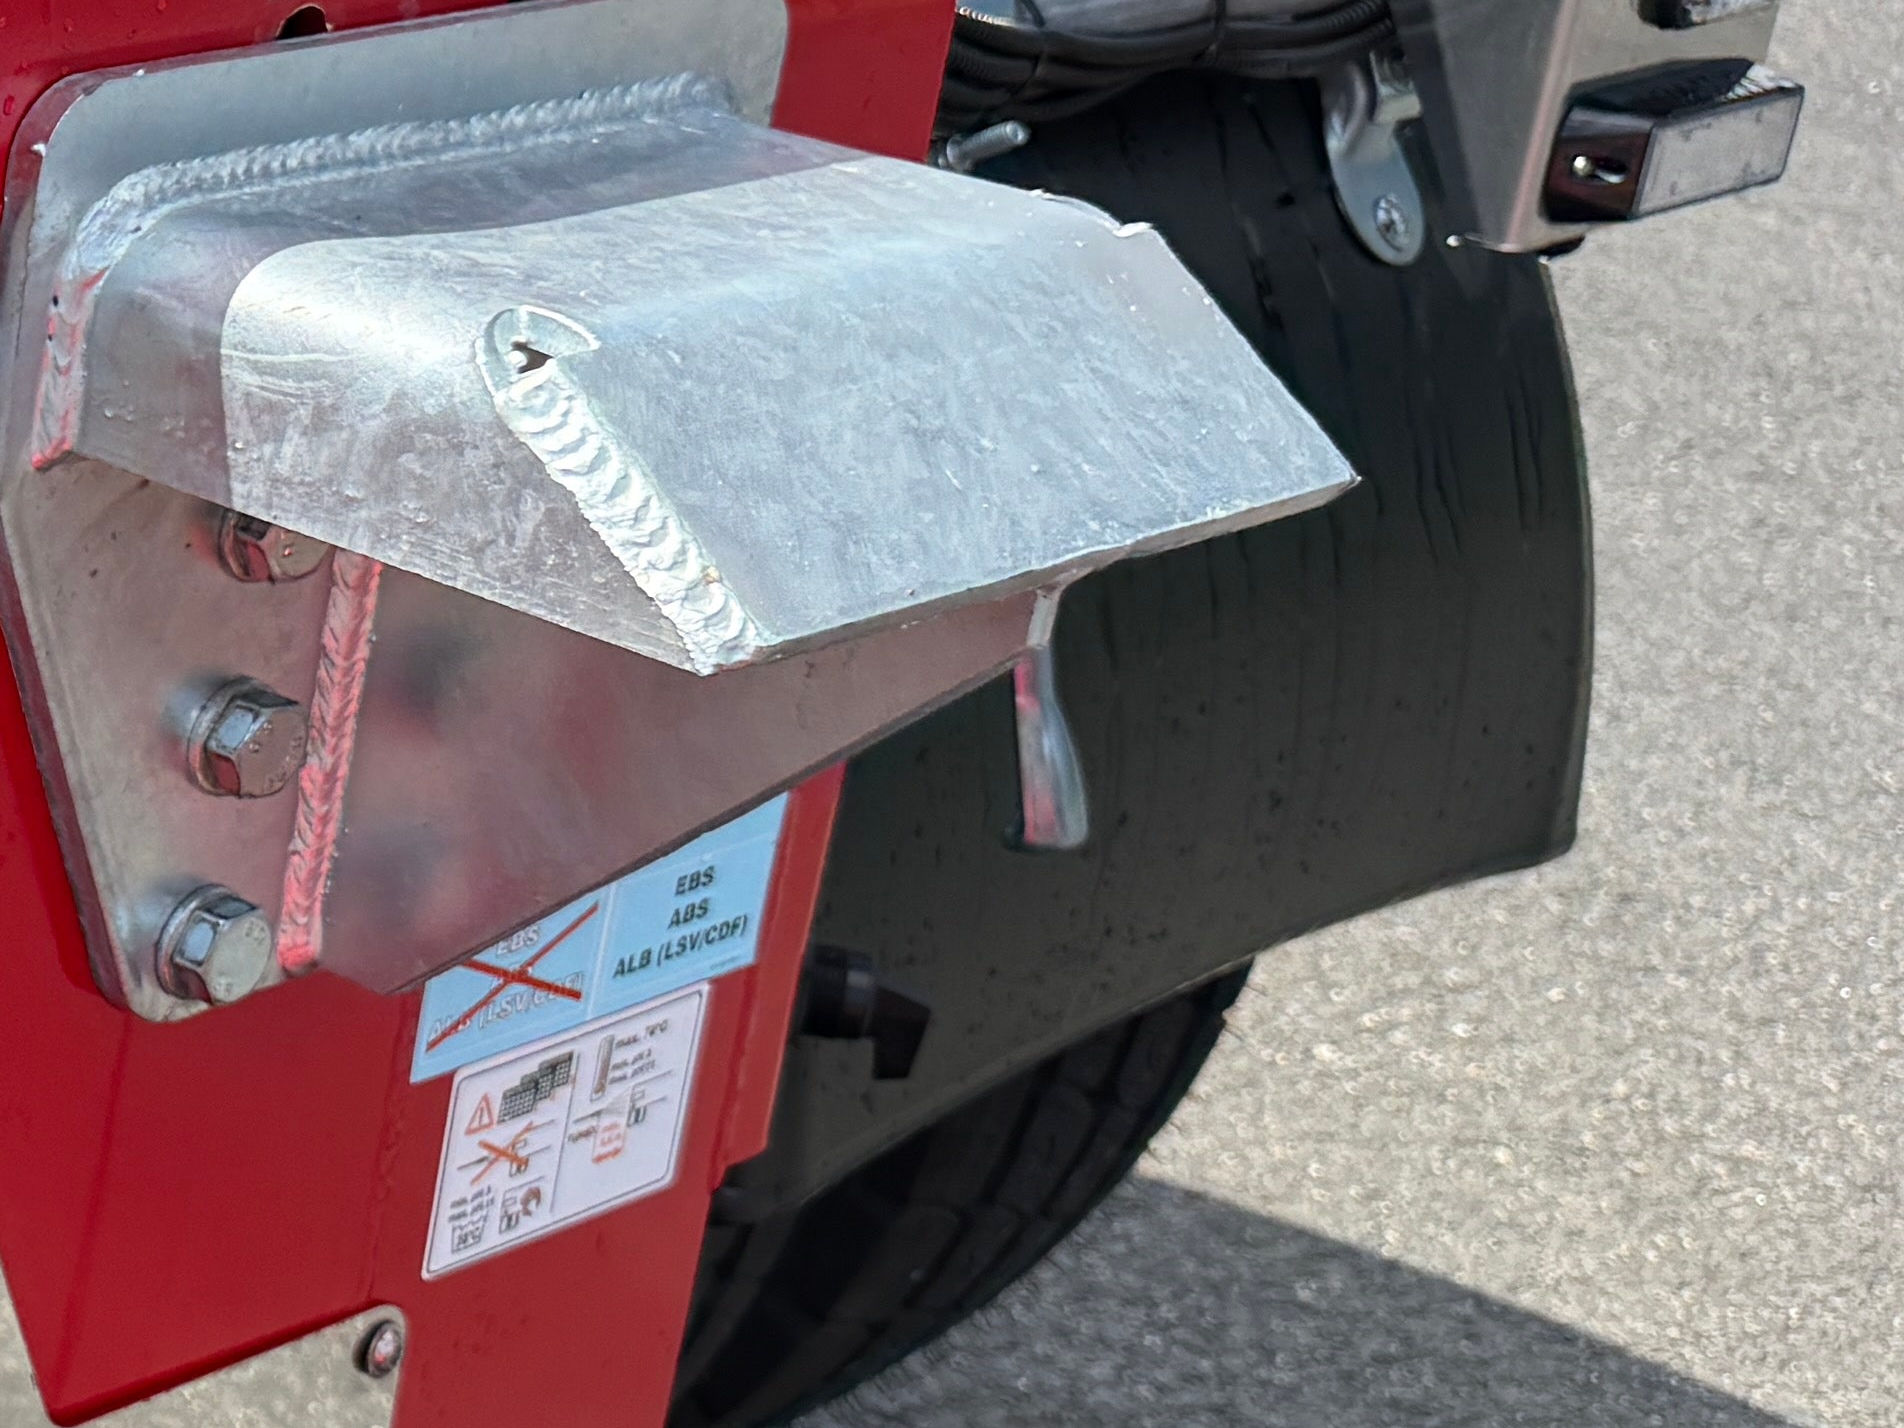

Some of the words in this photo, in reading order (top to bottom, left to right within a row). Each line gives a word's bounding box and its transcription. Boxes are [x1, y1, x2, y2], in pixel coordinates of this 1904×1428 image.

[675, 865, 714, 896] EBS
[667, 898, 709, 930] ABS
[612, 948, 652, 978] ALB
[657, 914, 748, 967] (LSV/CDF)
